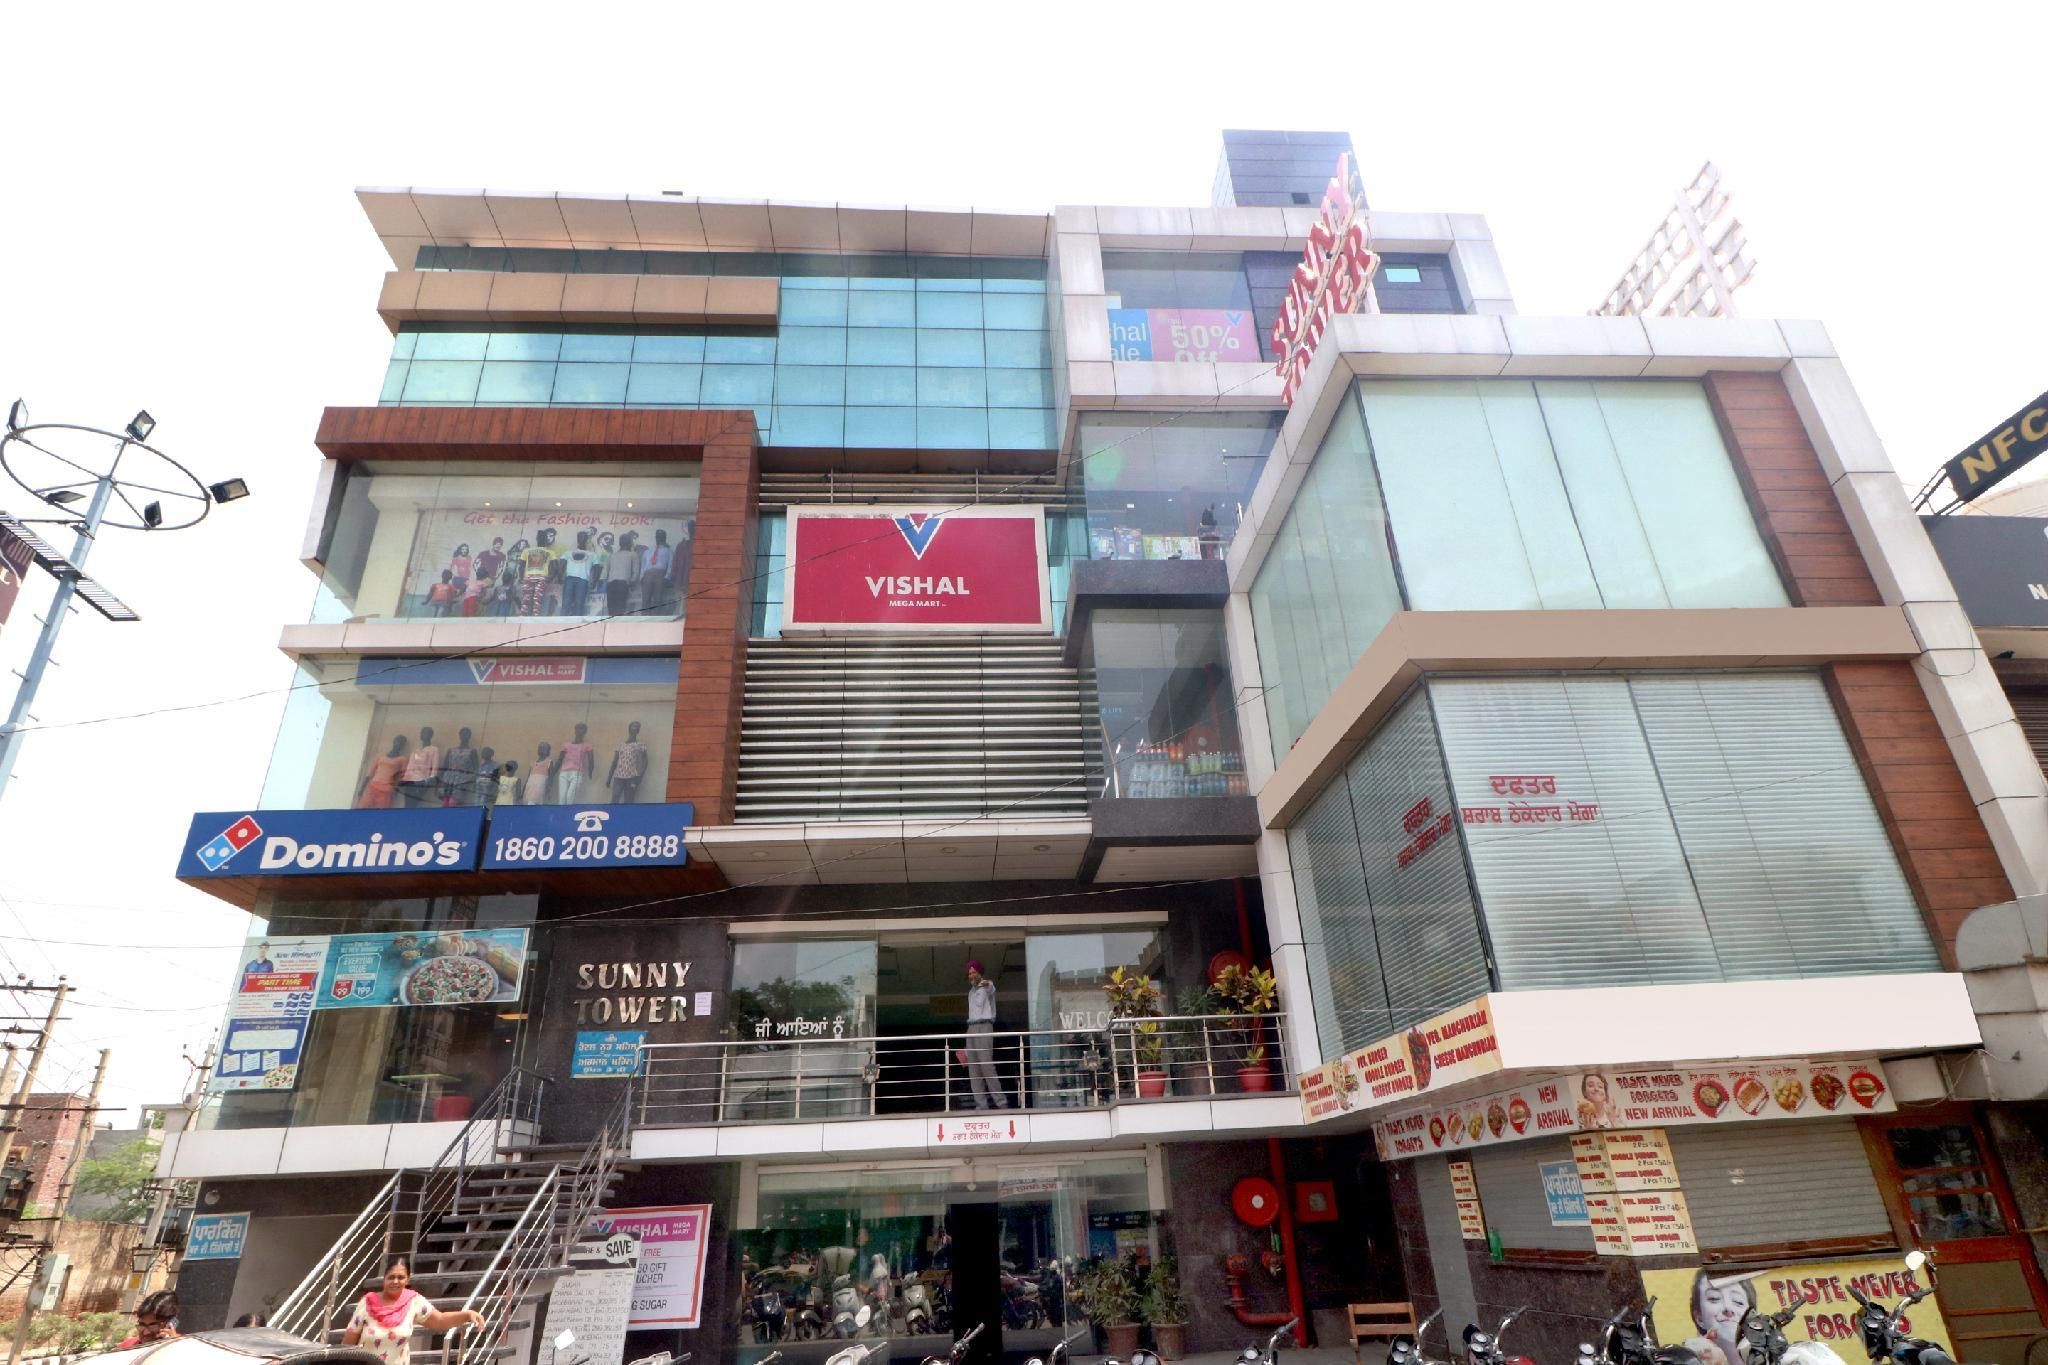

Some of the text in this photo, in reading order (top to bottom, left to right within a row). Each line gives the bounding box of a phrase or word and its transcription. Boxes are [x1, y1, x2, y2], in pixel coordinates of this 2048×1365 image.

[1170, 325, 1240, 349] 50%
[463, 511, 497, 525] Get
[502, 511, 529, 524] the
[537, 512, 602, 525] Fashion
[865, 576, 970, 598] VISHAL
[499, 664, 554, 677] VISHAL
[260, 831, 461, 870] Domino's
[495, 834, 679, 861] 1860 200 8888
[576, 961, 692, 990] SUNNY
[573, 995, 688, 1024] TOWER
[755, 1017, 772, 1038] ਜੀ
[776, 1016, 829, 1037] ਆਇਆਂ
[1615, 1074, 1650, 1089] TASTE
[1651, 1073, 1684, 1087] NEVER
[1537, 1085, 1558, 1105] NEW
[1630, 1089, 1679, 1104] FORGETS
[1536, 1107, 1574, 1131] ARRIVAL
[1624, 1105, 1697, 1121] NEW ARRIVAL
[672, 1228, 690, 1236] MART
[606, 1240, 632, 1258] SAVE
[643, 1248, 662, 1257] FREE
[649, 1262, 668, 1273] GIFT
[1769, 1270, 1921, 1308] TASTE NEVER
[640, 1300, 668, 1311] SUGAR
